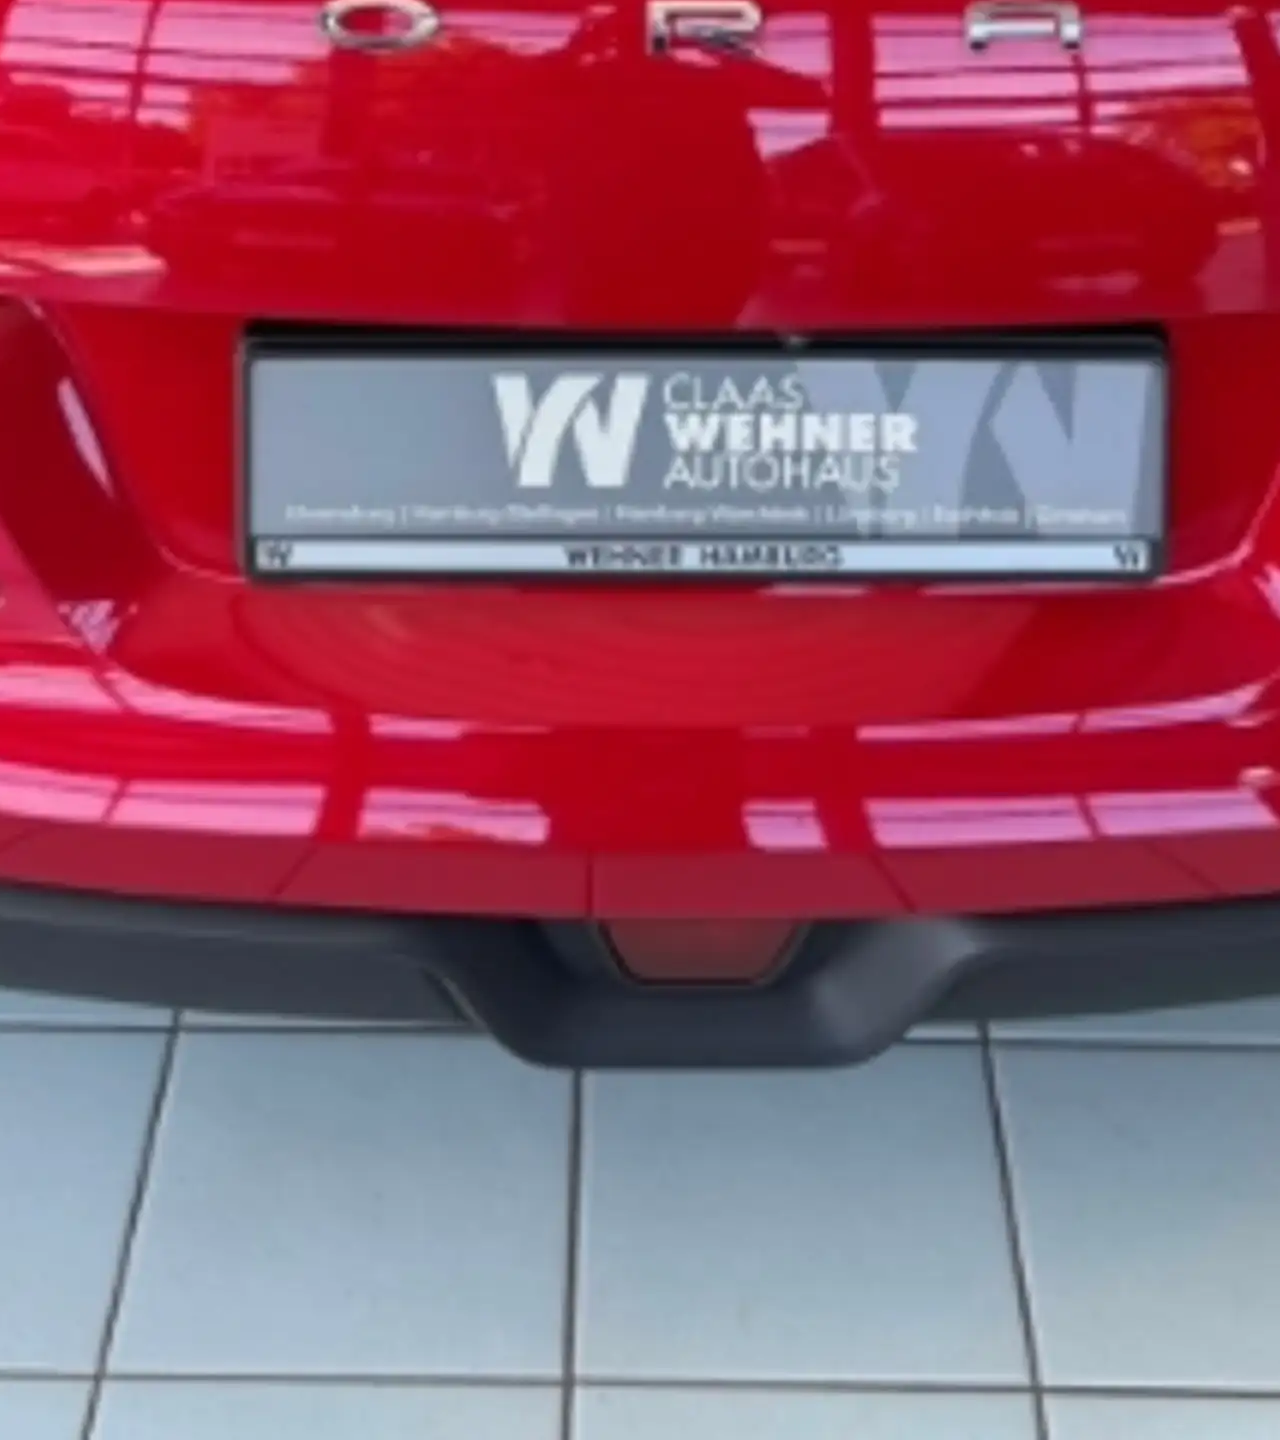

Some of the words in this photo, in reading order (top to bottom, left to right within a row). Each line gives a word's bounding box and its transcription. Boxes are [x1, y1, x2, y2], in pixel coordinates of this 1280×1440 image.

[663, 371, 805, 410] CLAAS
[663, 412, 918, 453] WEHNER
[663, 454, 901, 492] AUTOHAUS
